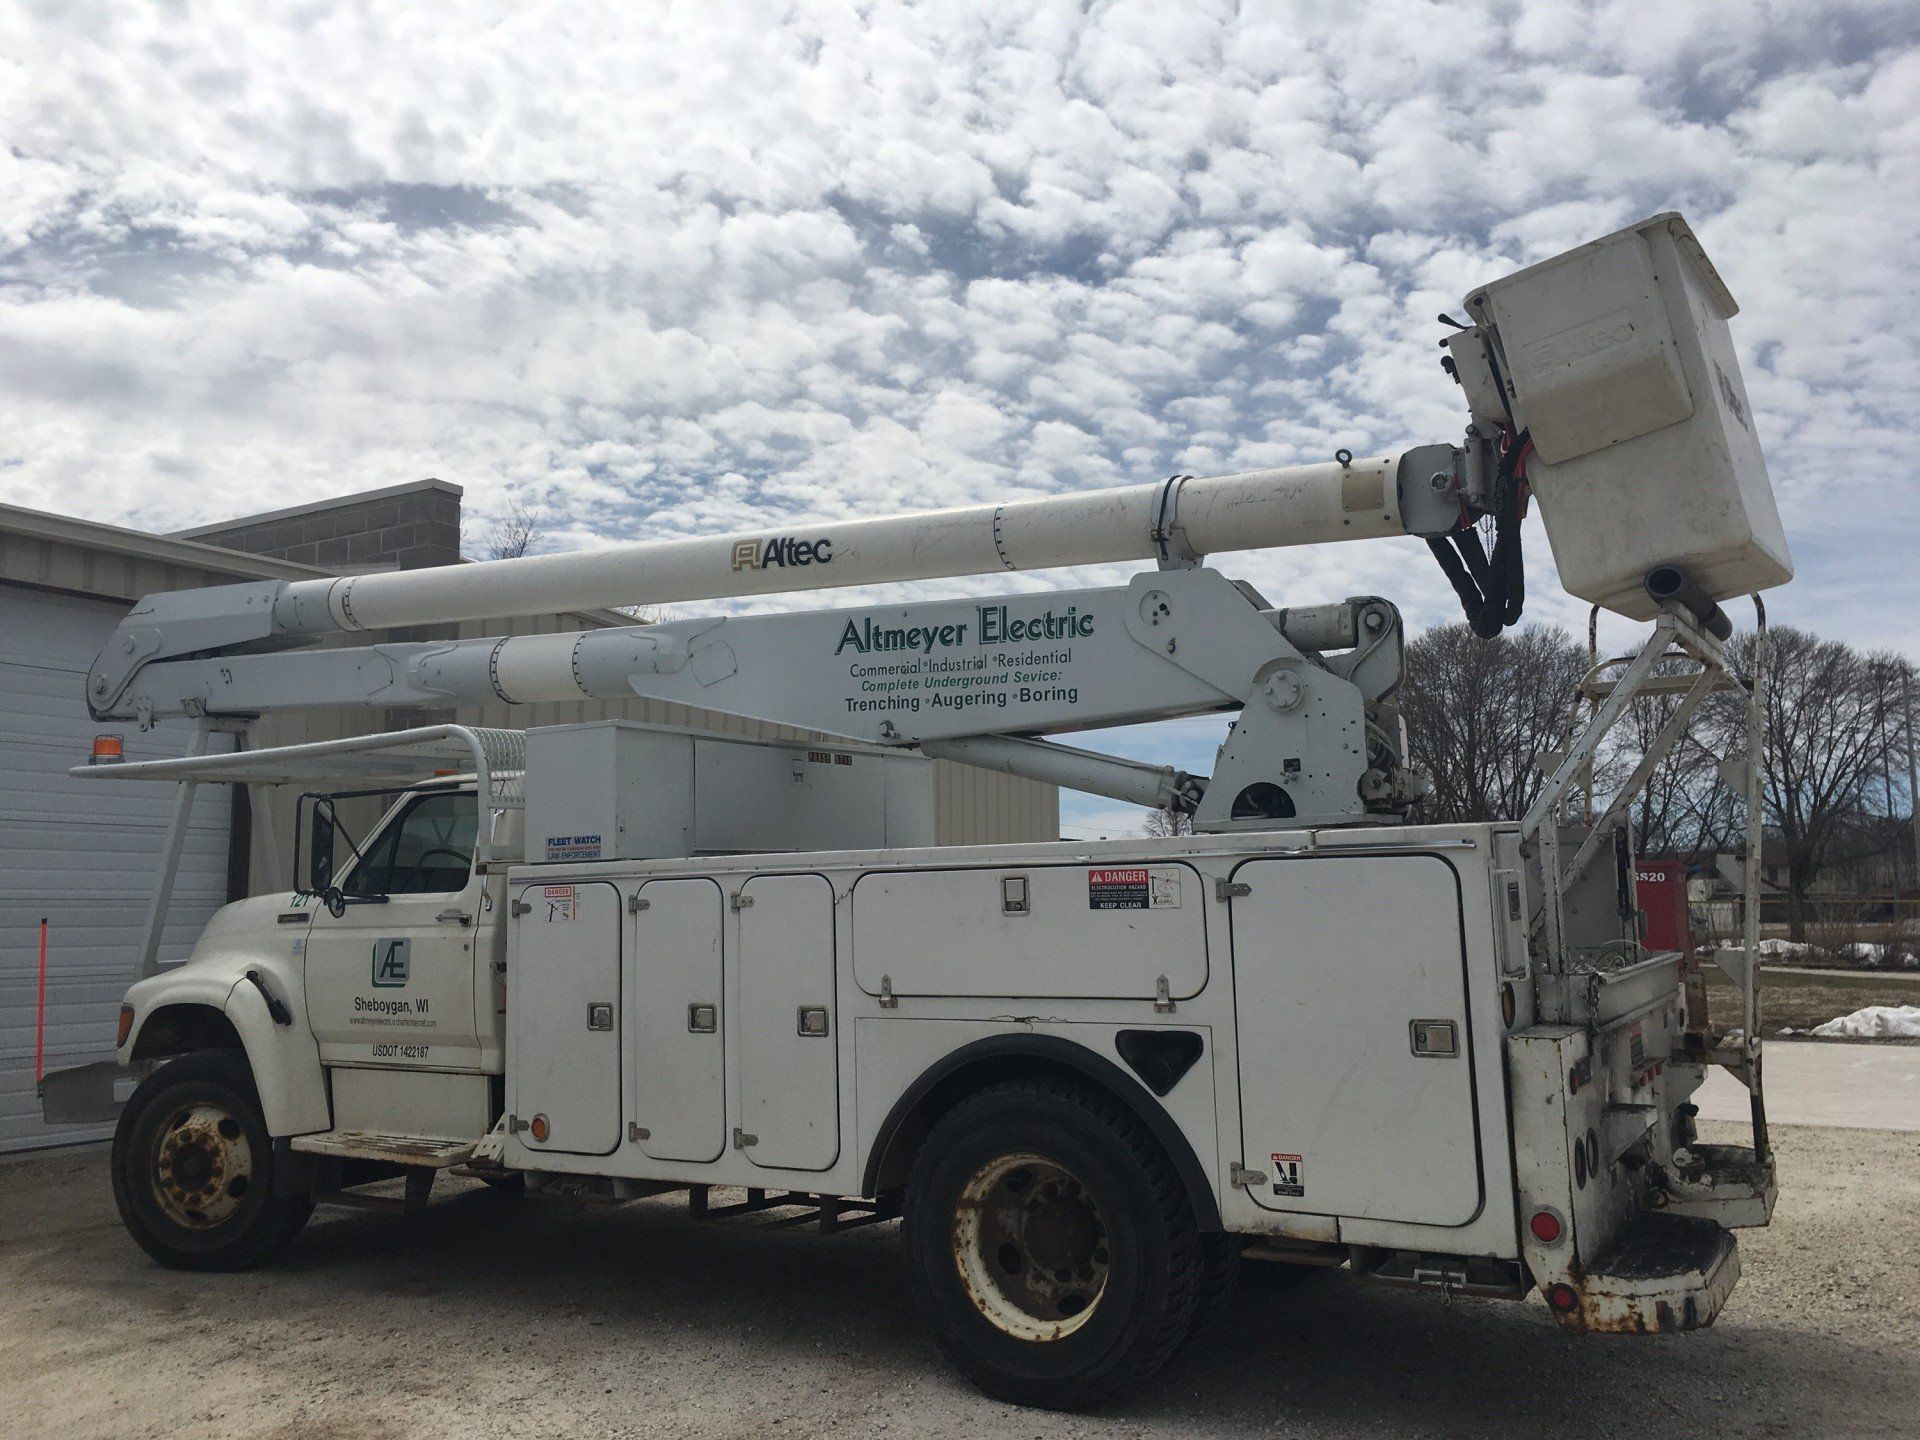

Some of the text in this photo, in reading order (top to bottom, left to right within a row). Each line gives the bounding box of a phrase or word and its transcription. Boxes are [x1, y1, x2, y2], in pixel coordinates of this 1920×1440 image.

[761, 537, 832, 568] Altec
[834, 605, 1094, 655] Altmeyer Electric
[850, 647, 1072, 677] Commercial Industrial Residential
[861, 670, 1062, 692] Complete Underground Sevice:
[845, 686, 1078, 712] Trenching Augering Boring
[548, 835, 601, 846] FLEET WATCH
[561, 850, 601, 859] ENFORCEMENT
[1104, 871, 1146, 882] DANGER
[1119, 901, 1142, 909] CLEAR
[354, 996, 429, 1016] Sheboygan, WI
[372, 1044, 429, 1059] USDOT 1422187
